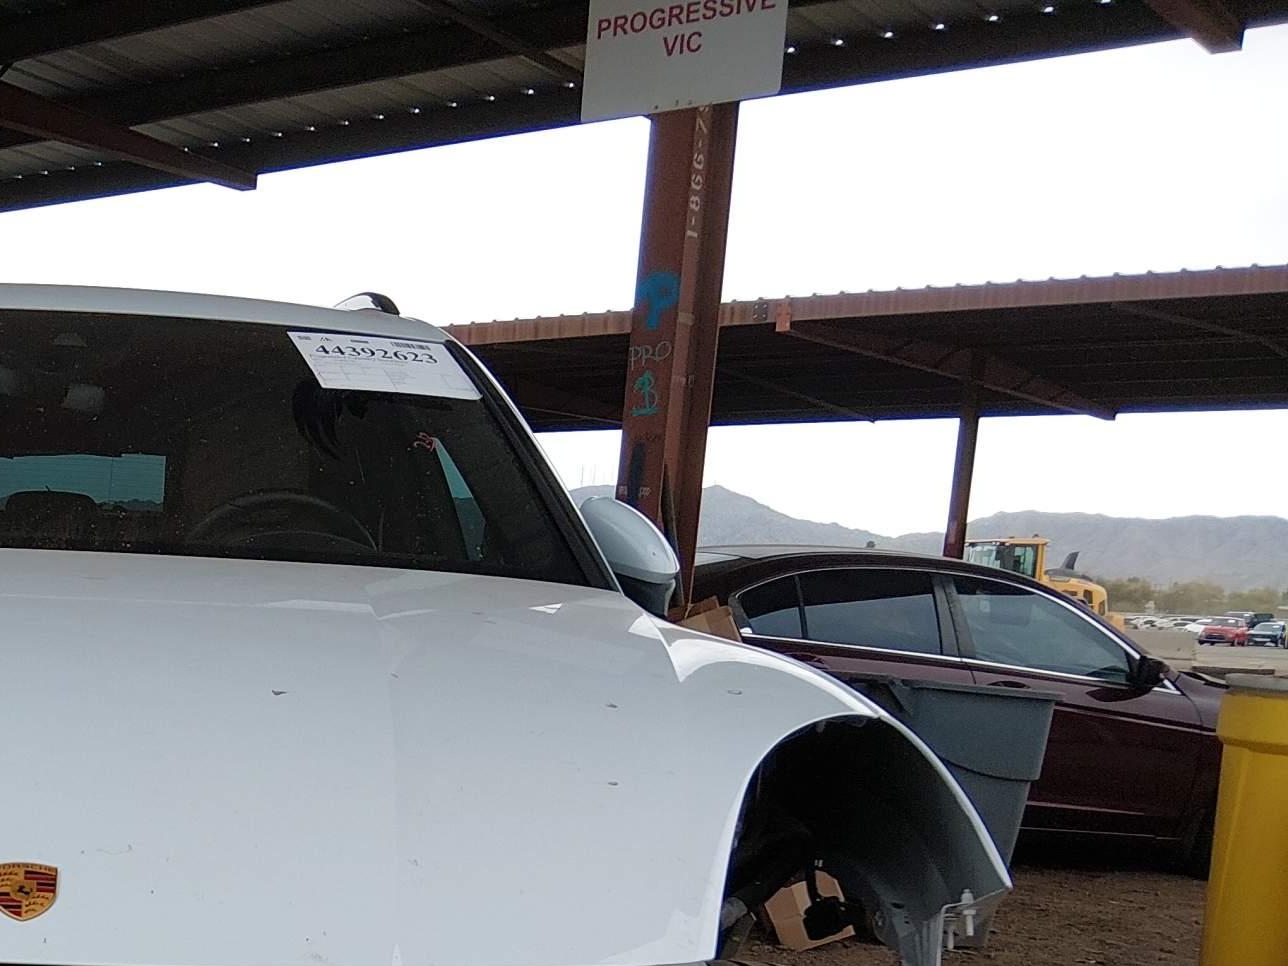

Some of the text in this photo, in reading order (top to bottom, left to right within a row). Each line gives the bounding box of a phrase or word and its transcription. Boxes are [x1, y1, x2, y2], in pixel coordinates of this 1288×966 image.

[663, 31, 703, 57] VIC
[315, 344, 439, 365] 44392623
[628, 340, 672, 370] PRO
